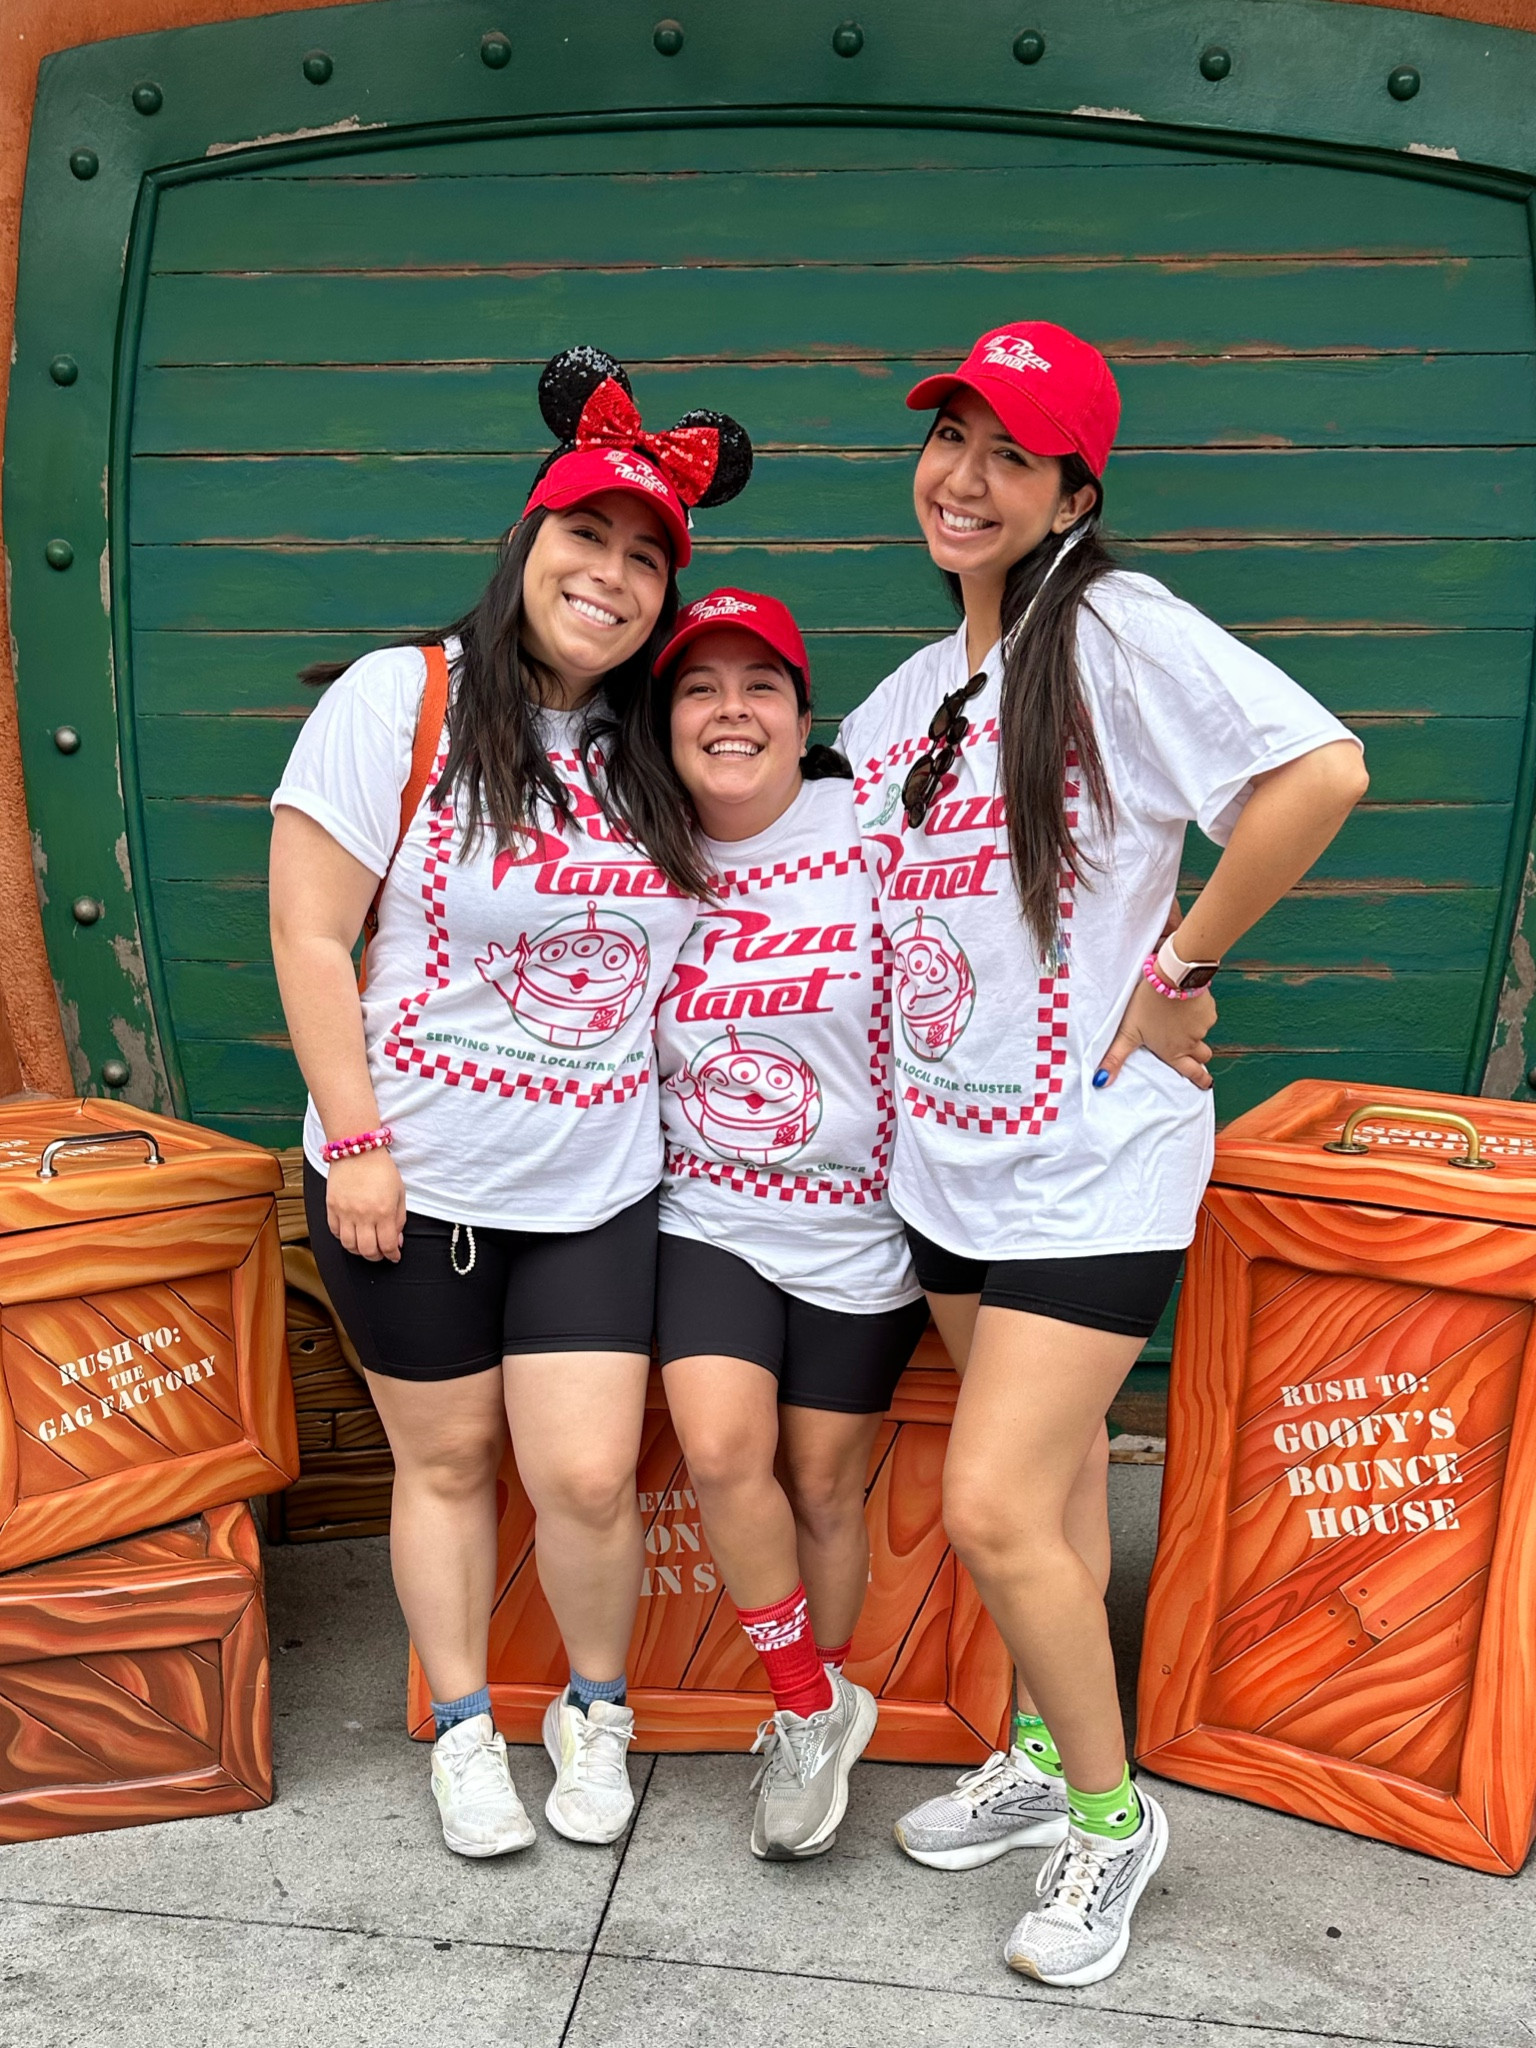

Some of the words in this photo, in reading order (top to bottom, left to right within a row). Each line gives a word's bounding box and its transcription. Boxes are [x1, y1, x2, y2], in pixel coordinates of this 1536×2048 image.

[696, 909, 857, 965] Pizza
[425, 1031, 490, 1052] SERVING
[495, 1044, 537, 1062] YOUR
[583, 1061, 616, 1072] STAR
[903, 1062, 931, 1083] LOCAL
[933, 1076, 960, 1091] STAR
[963, 1083, 1023, 1094] CLUSTER
[1333, 1122, 1534, 1148] ASSORTE
[59, 1340, 134, 1387] RUSH
[137, 1327, 181, 1355] TO:
[107, 1364, 145, 1390] THE
[38, 1404, 94, 1443] GAG
[100, 1355, 217, 1420] FACTORY
[1280, 1377, 1368, 1408] RUSH
[1375, 1371, 1430, 1398] TO:
[1273, 1406, 1456, 1455] GOOFY'S
[1284, 1452, 1464, 1498] BOUNCE
[637, 1489, 698, 1513] ELIV
[1305, 1498, 1461, 1540] HOUSE
